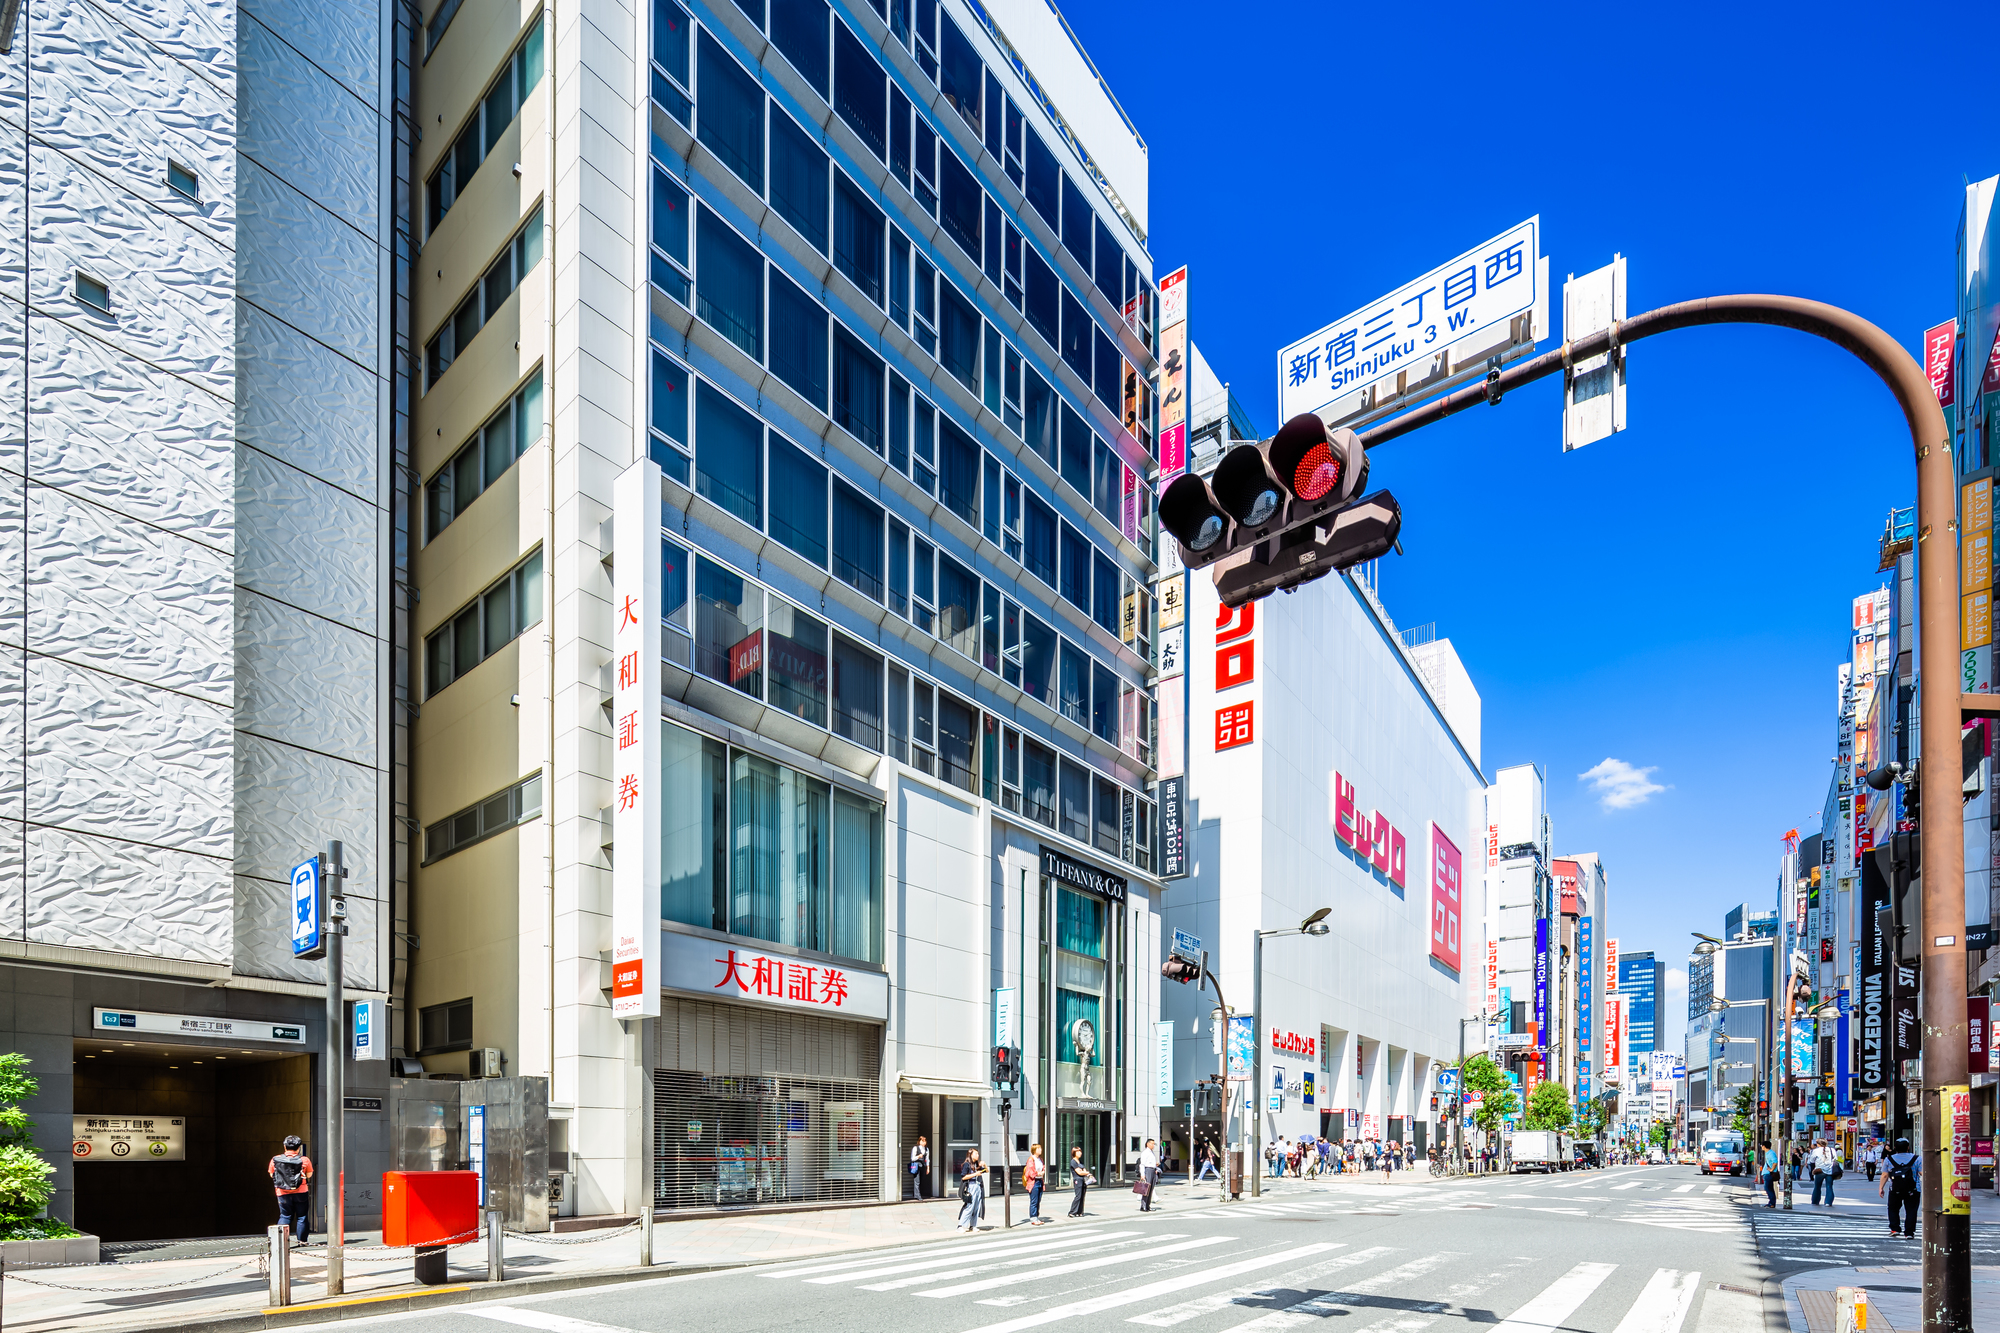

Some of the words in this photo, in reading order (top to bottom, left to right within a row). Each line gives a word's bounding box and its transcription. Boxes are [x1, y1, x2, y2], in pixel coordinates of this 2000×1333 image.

[1289, 240, 1524, 387] 新宿三丁目西
[1331, 338, 1415, 390] Shinjuku
[1424, 324, 1437, 344] 3
[1447, 307, 1475, 332] W.
[1931, 333, 1950, 400] アカネビル
[1162, 586, 1182, 615] 車
[1162, 643, 1177, 671] 太助
[618, 594, 638, 813] 大和証券
[1335, 770, 1405, 888] ビックロ
[616, 945, 640, 958] Securities
[620, 936, 635, 947] Daiwa
[714, 949, 848, 1007] 大和証券
[1537, 951, 1546, 986] WATCH.
[1840, 995, 1850, 1015] AOKI
[1864, 972, 1882, 1084] CALZEDONIA
[1874, 937, 1882, 966] ITALIAN
[1272, 1027, 1315, 1056] ビックカメラ
[1898, 1008, 1914, 1050] Hawaii
[1970, 1018, 1982, 1053] 無印良品
[1654, 1053, 1674, 1064] カラオケ
[1304, 1080, 1315, 1096] GU
[86, 1119, 154, 1129] 新宿三丁目駅
